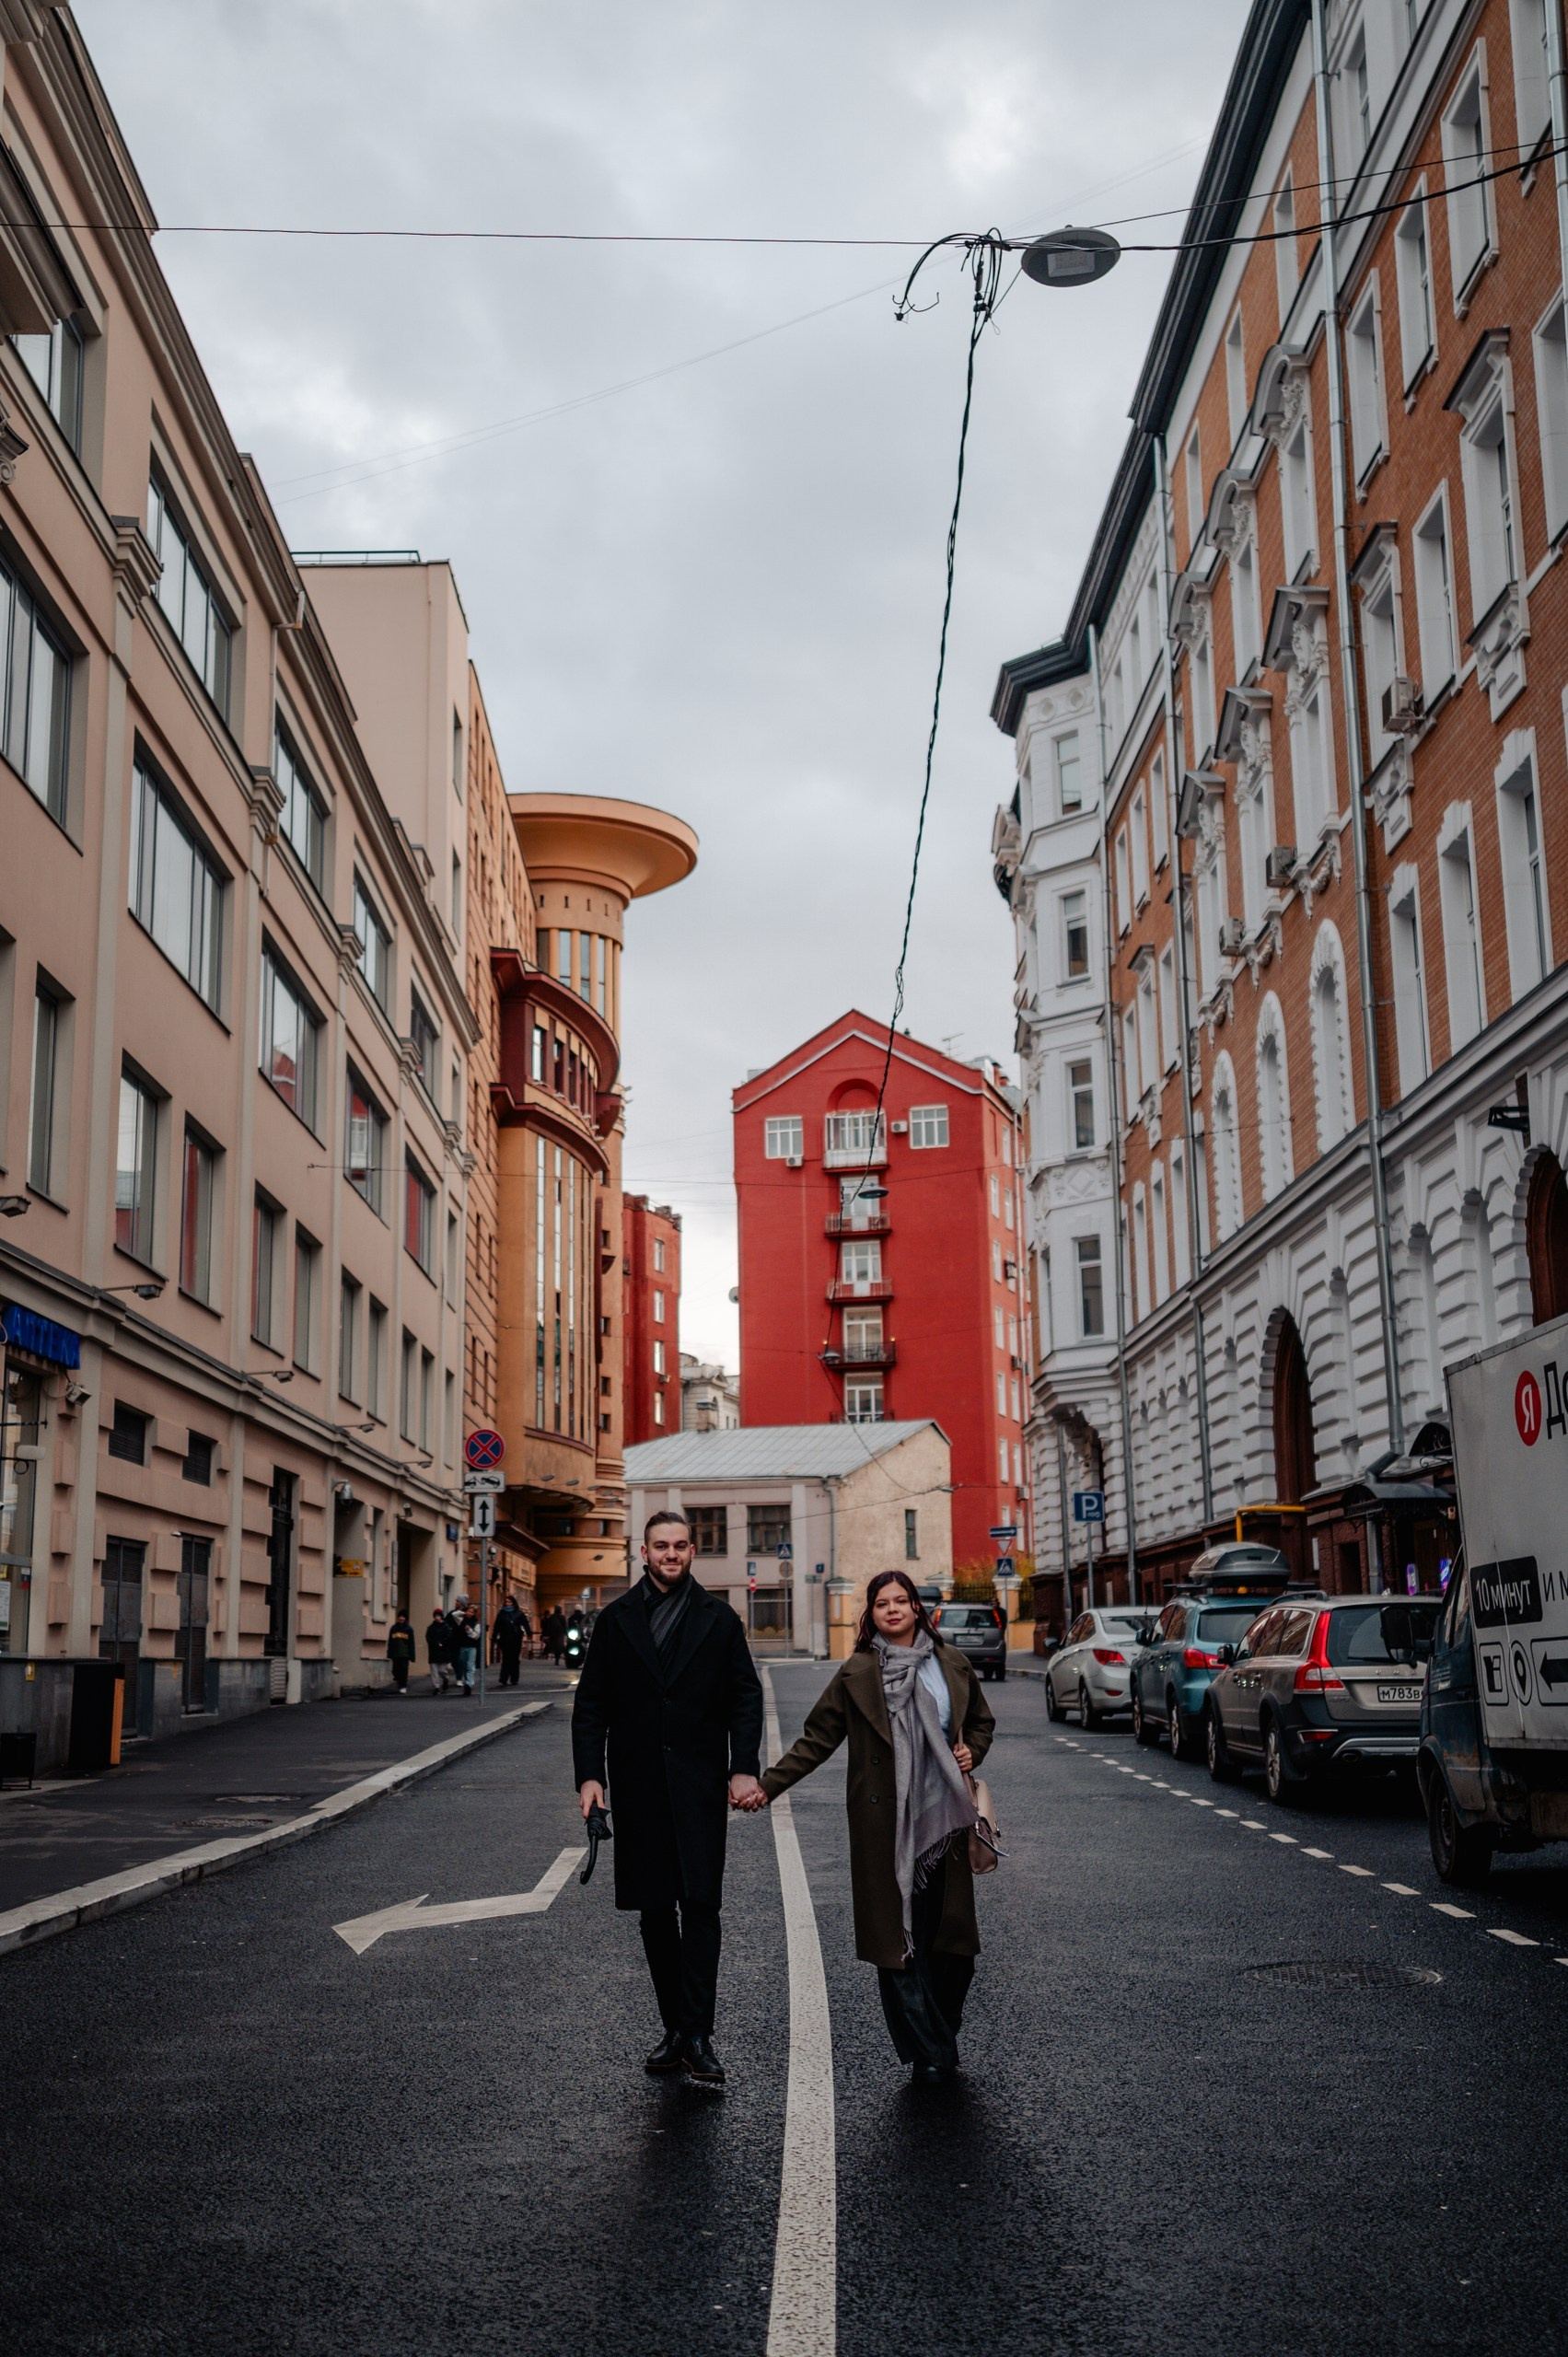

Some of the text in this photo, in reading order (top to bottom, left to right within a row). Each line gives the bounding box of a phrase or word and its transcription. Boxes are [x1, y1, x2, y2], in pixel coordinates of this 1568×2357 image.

[1521, 1384, 1535, 1434] Я
[1082, 1495, 1098, 1519] P
[1476, 1578, 1490, 1611] 10
[1490, 1579, 1530, 1615] минут
